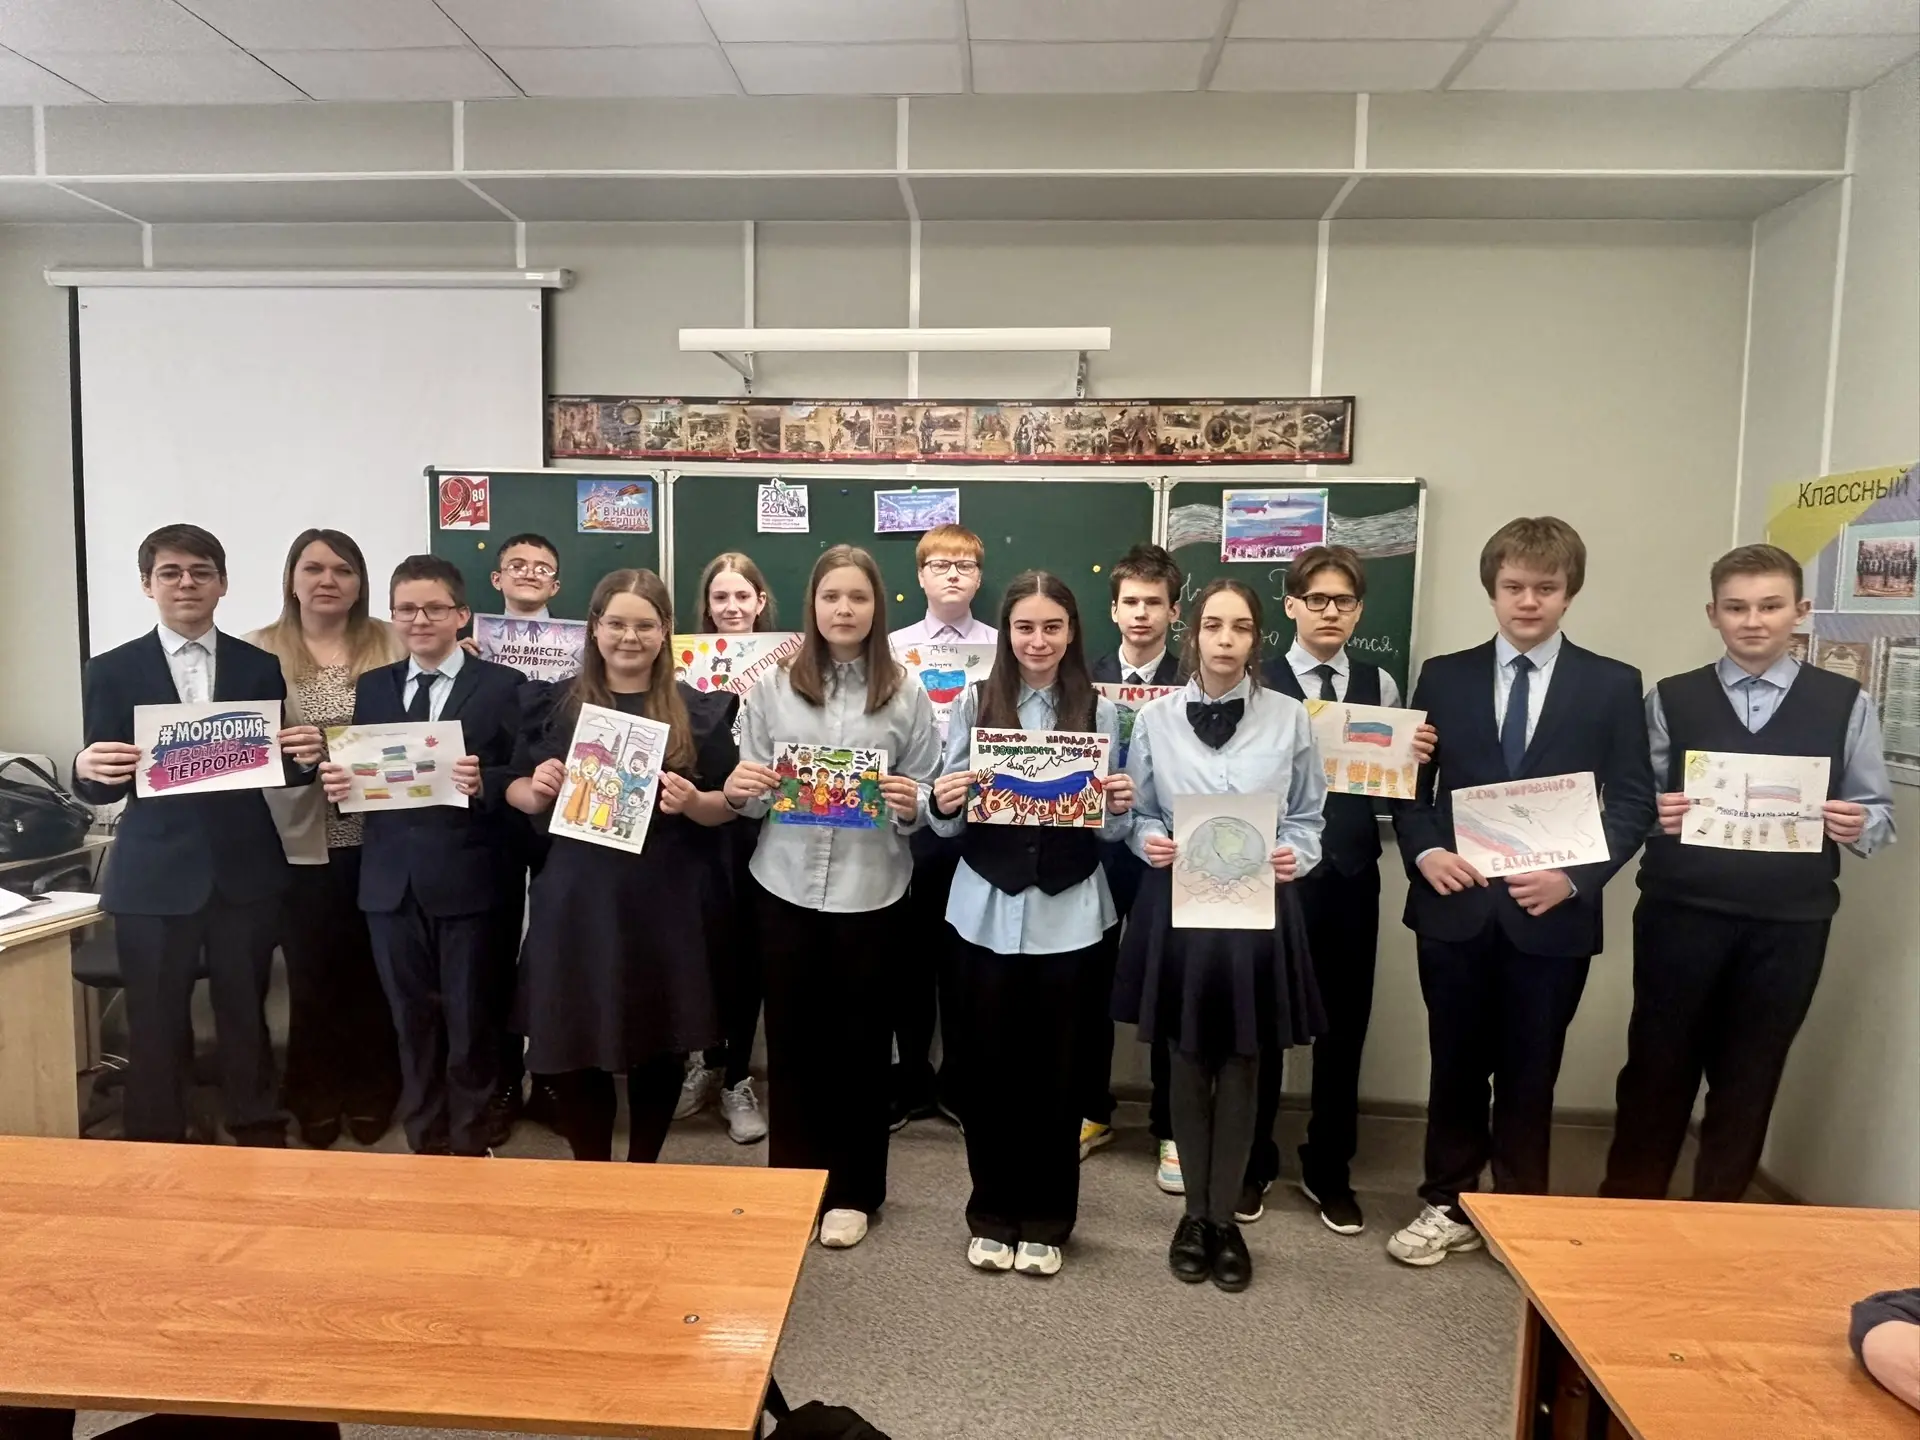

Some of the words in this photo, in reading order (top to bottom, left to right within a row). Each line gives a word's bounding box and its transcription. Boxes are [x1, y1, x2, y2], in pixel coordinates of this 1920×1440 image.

[472, 488, 485, 502] 80
[1797, 467, 1910, 509] Классный
[761, 489, 778, 502] 20
[603, 507, 610, 516] В
[613, 507, 649, 517] НАШИХ
[761, 502, 778, 514] 26
[603, 517, 649, 528] СЕРДЦАХ
[501, 644, 520, 654] МЫ
[492, 654, 538, 666] ПРОТИВ
[538, 659, 575, 667] ТЕРРОРА
[1119, 686, 1182, 701] ПРОТИ
[160, 718, 264, 745] #МОРДОВИЯ
[163, 739, 242, 766] ПРОТИВ
[167, 748, 257, 781] ТЕРРОРА!
[1491, 849, 1578, 872] ЕДИНСТВА
